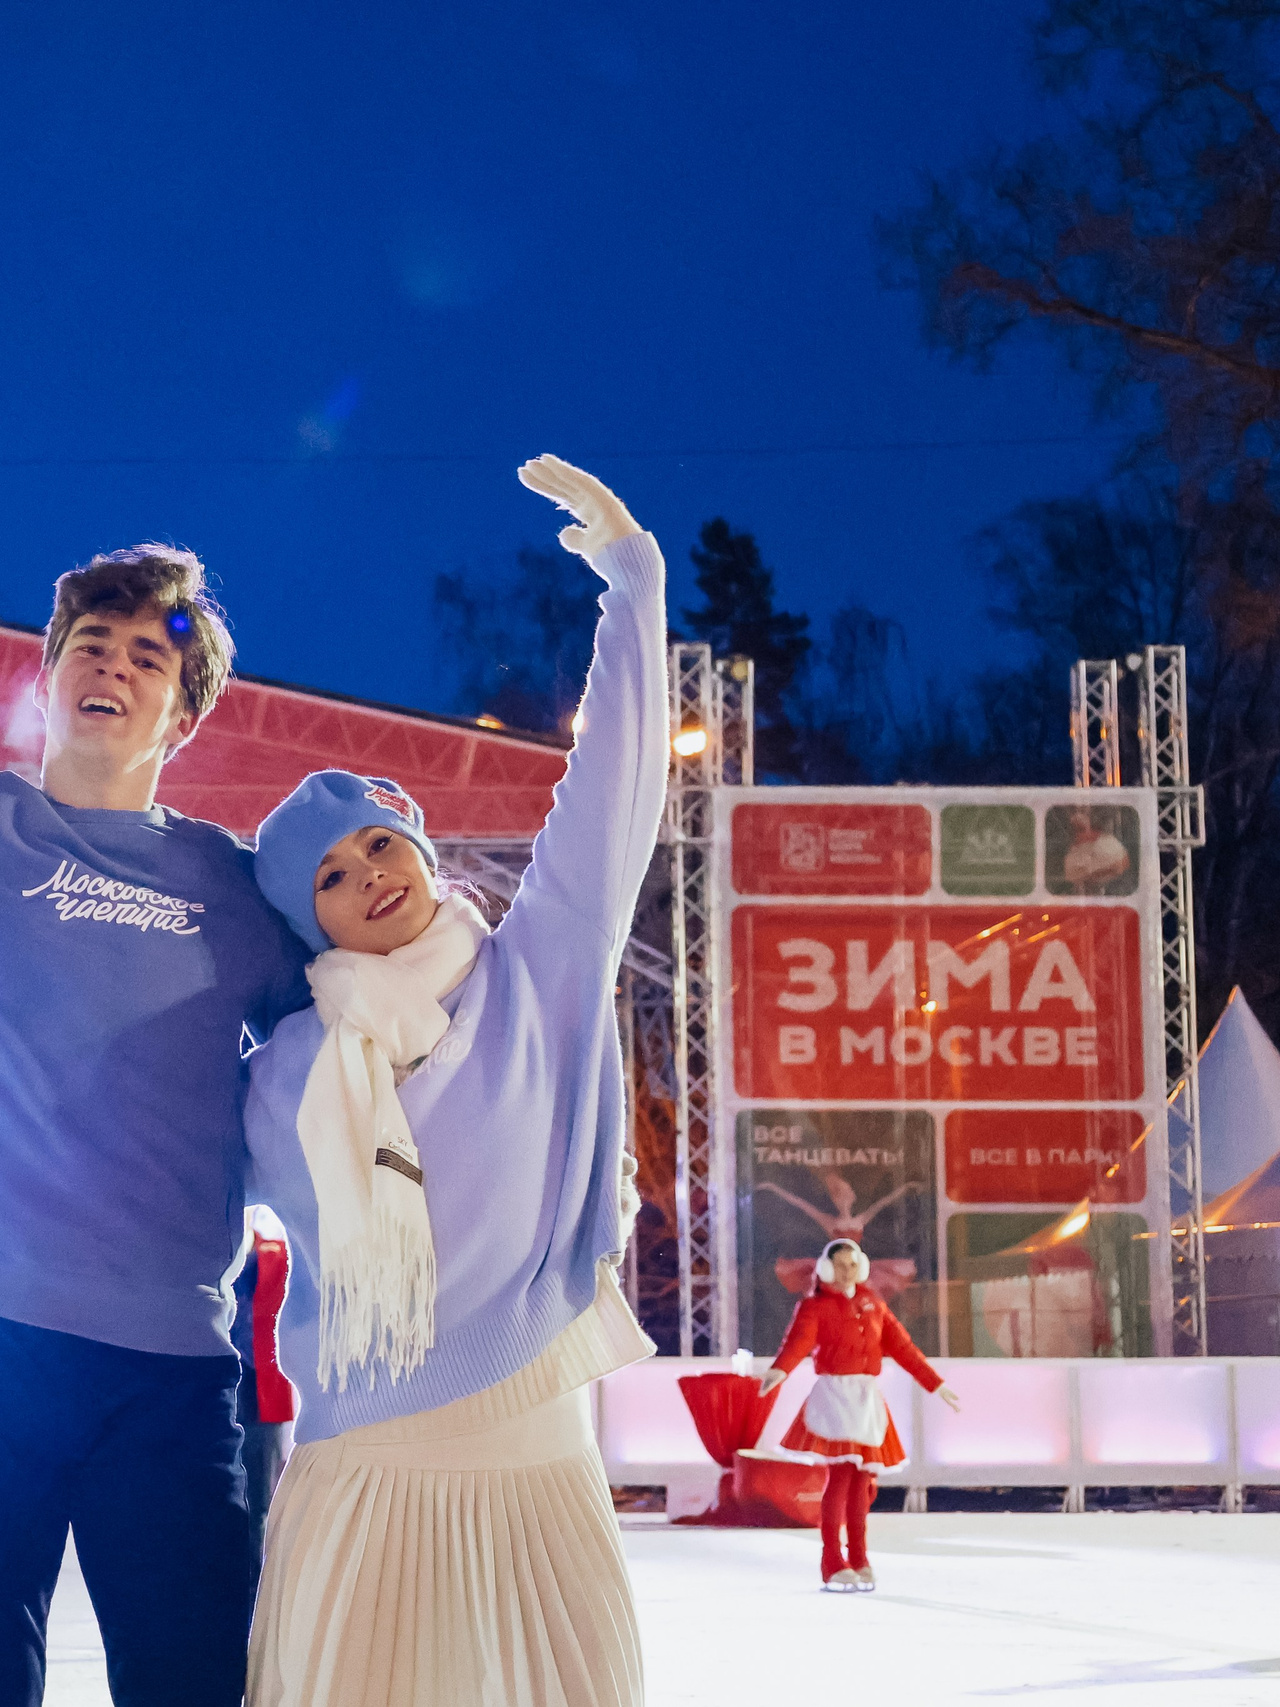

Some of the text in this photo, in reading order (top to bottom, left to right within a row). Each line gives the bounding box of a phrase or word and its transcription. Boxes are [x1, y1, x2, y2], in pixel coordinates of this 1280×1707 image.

[22, 860, 205, 913] Московское
[776, 937, 1097, 1013] ЗИМА
[778, 1025, 1098, 1067] В МОСКВЕ
[754, 1125, 803, 1144] ВСЕ
[970, 1147, 1018, 1166] ВСЕ
[1025, 1147, 1041, 1166] В
